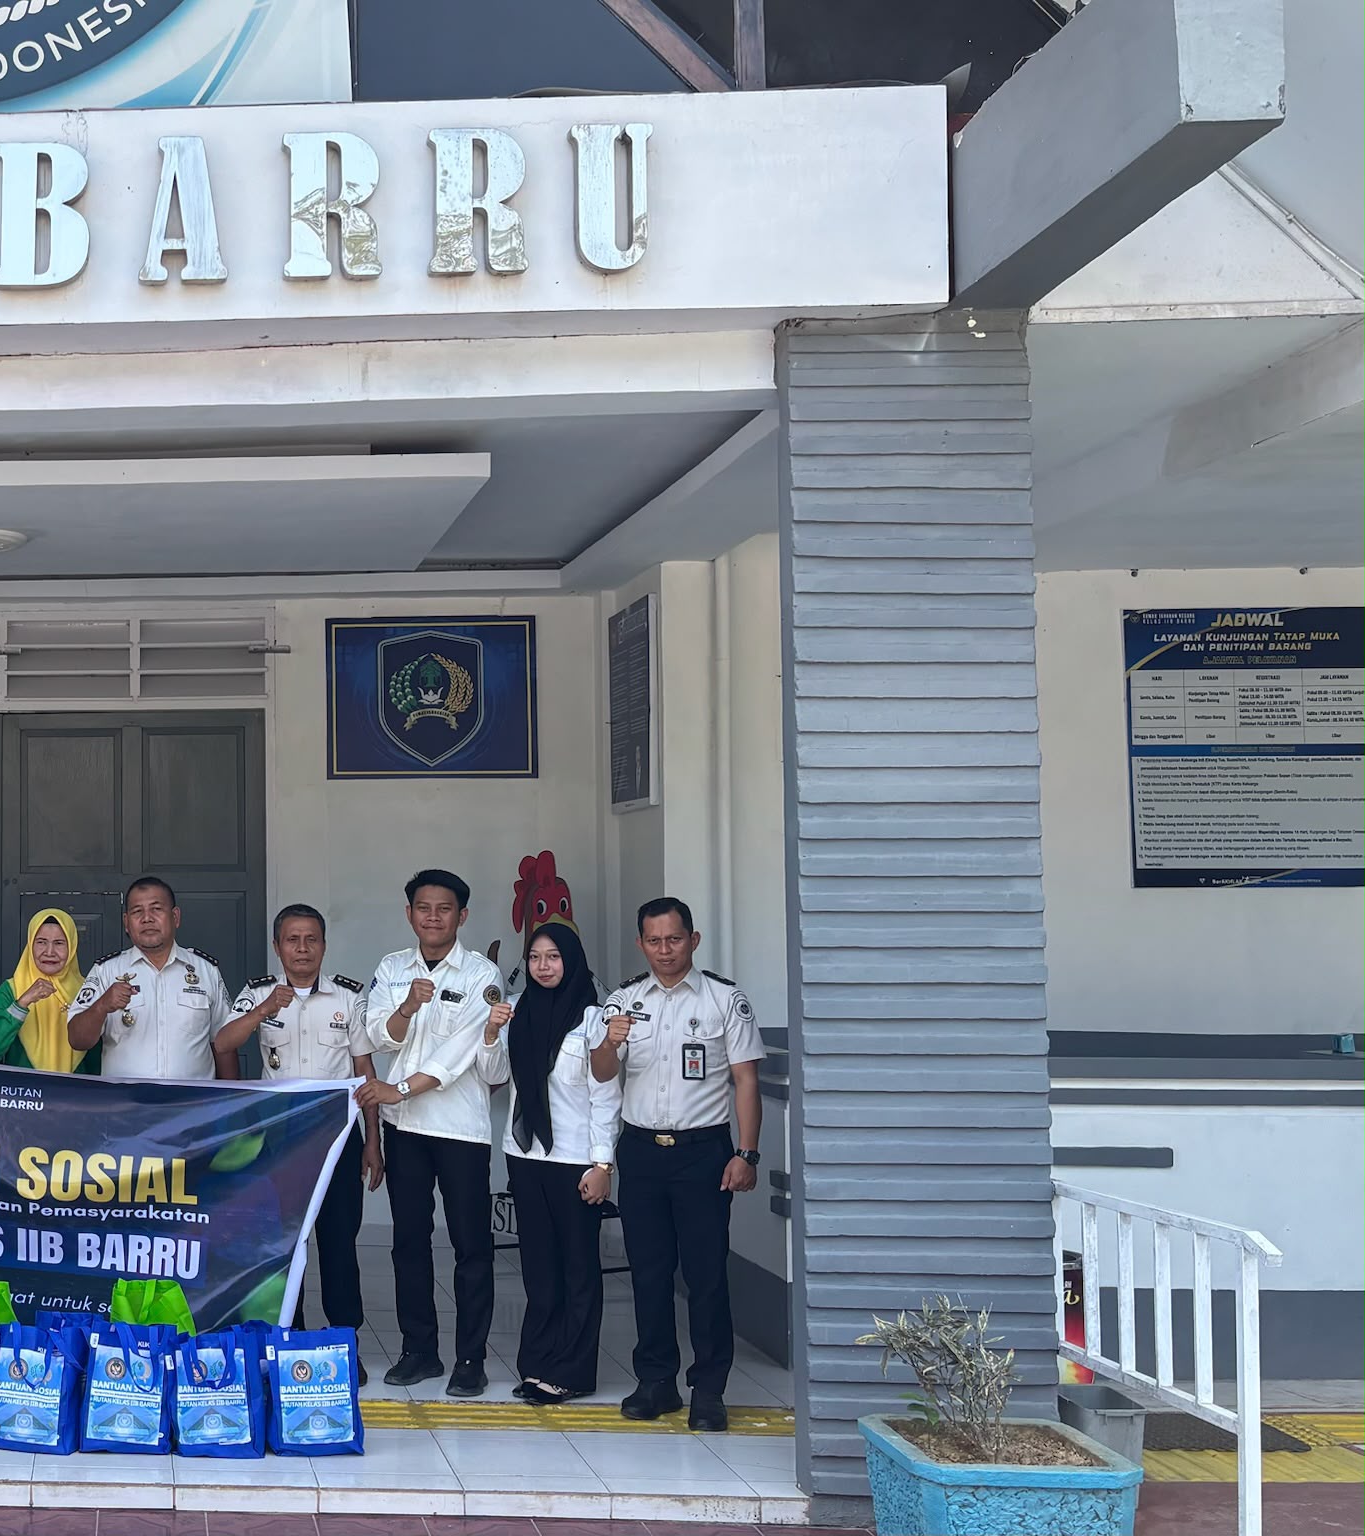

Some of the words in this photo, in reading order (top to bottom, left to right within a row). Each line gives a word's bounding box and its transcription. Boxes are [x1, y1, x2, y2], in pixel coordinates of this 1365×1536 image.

[1211, 613, 1284, 627] JADWAL
[1154, 633, 1201, 642] LAYANAN
[1206, 633, 1269, 641] KUNJUNGAN
[1274, 632, 1306, 641] TATAP
[1310, 632, 1339, 640] MUKA
[1183, 643, 1204, 651] DAN
[1209, 643, 1264, 651] PENITIPAN
[1269, 642, 1312, 650] BARANG
[1, 1086, 42, 1098] RUTAN
[0, 1099, 43, 1111] BARRU
[16, 1147, 197, 1205] SOSIAL
[29, 1200, 210, 1223] Pemasyarakatan
[17, 1227, 64, 1265] IIB
[77, 1232, 201, 1280] BARRU
[41, 1295, 93, 1311] untuk
[92, 1379, 132, 1392] BANTUAN
[280, 1384, 321, 1394] BANTUAN
[322, 1383, 350, 1392] SOSIAL
